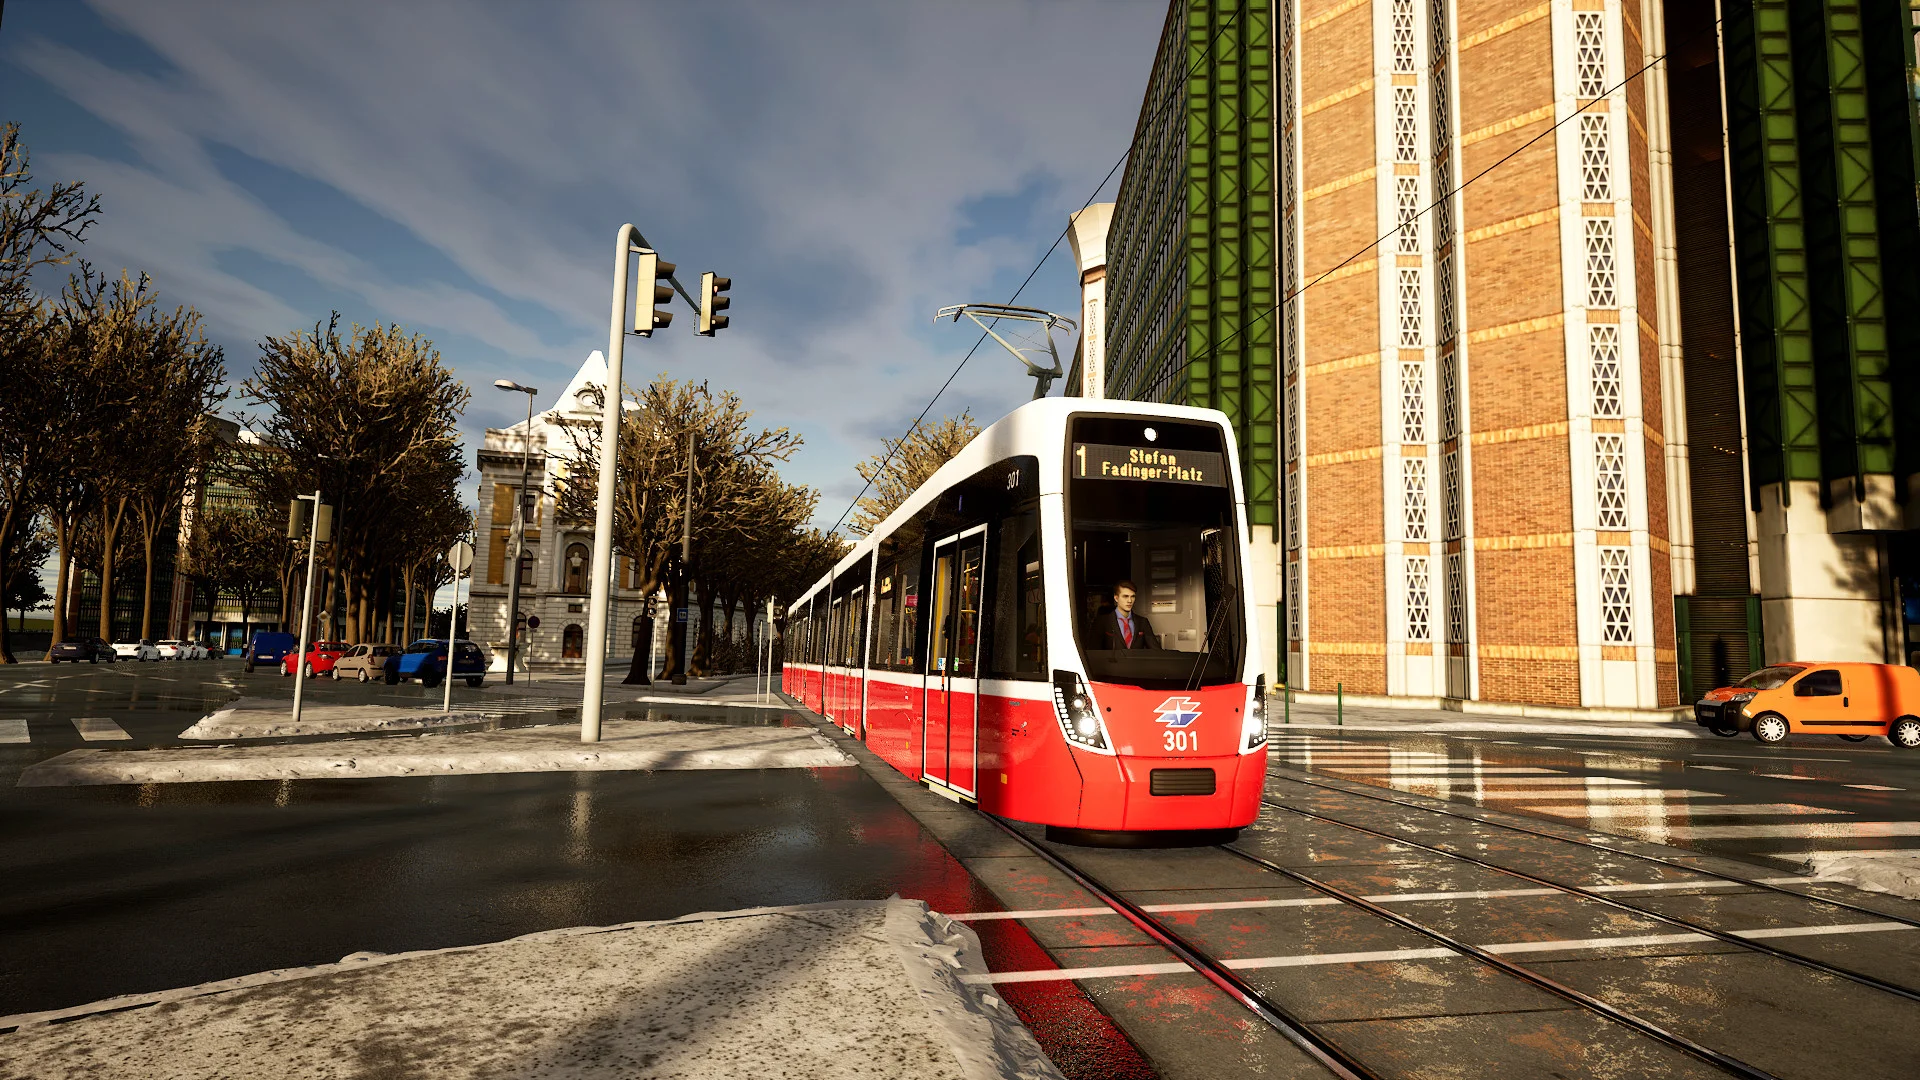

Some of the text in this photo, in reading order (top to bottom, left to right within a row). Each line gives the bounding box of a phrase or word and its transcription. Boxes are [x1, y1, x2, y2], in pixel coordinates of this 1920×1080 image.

[1076, 445, 1087, 477] 1
[1129, 448, 1177, 466] Stefan
[1006, 469, 1020, 491] 301
[1102, 461, 1203, 482] Fadinger-Platz
[1163, 730, 1198, 752] 301
